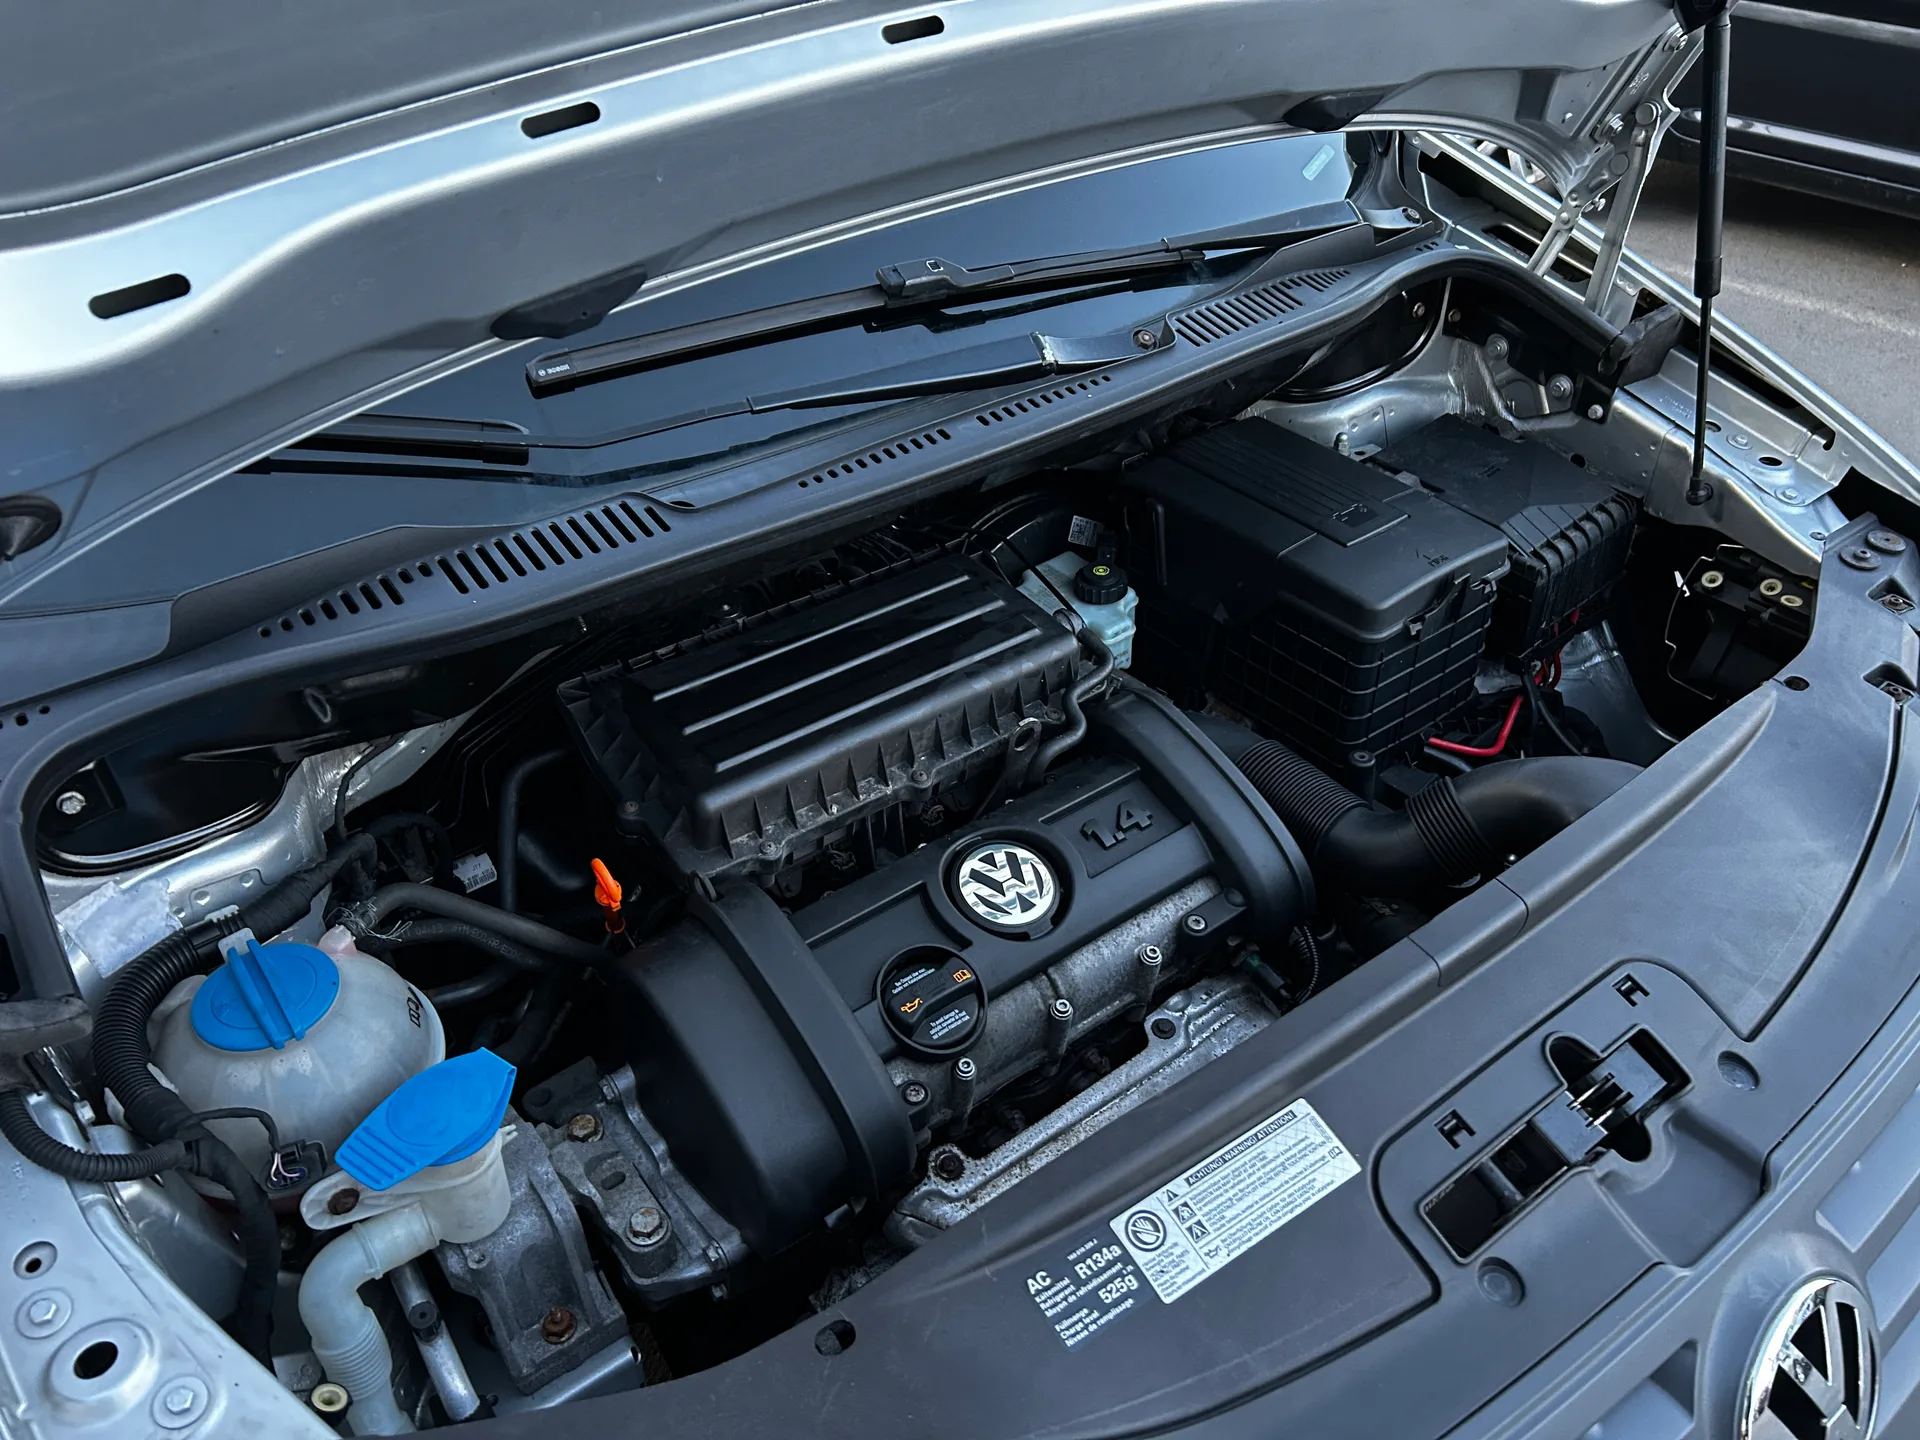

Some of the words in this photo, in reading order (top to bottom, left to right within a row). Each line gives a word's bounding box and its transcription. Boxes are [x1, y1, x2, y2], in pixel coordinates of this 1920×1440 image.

[1080, 799, 1153, 850] 1.4
[1186, 1157, 1224, 1184] ACHTUNG!
[1221, 1135, 1258, 1161] WARNING!
[1255, 1111, 1294, 1139] ATTENTION!
[1026, 1270, 1051, 1295] AC
[1074, 1244, 1123, 1280] R134a
[1097, 1273, 1140, 1304] 525g
[1059, 1321, 1084, 1340] Charge
[1083, 1309, 1100, 1325] level
